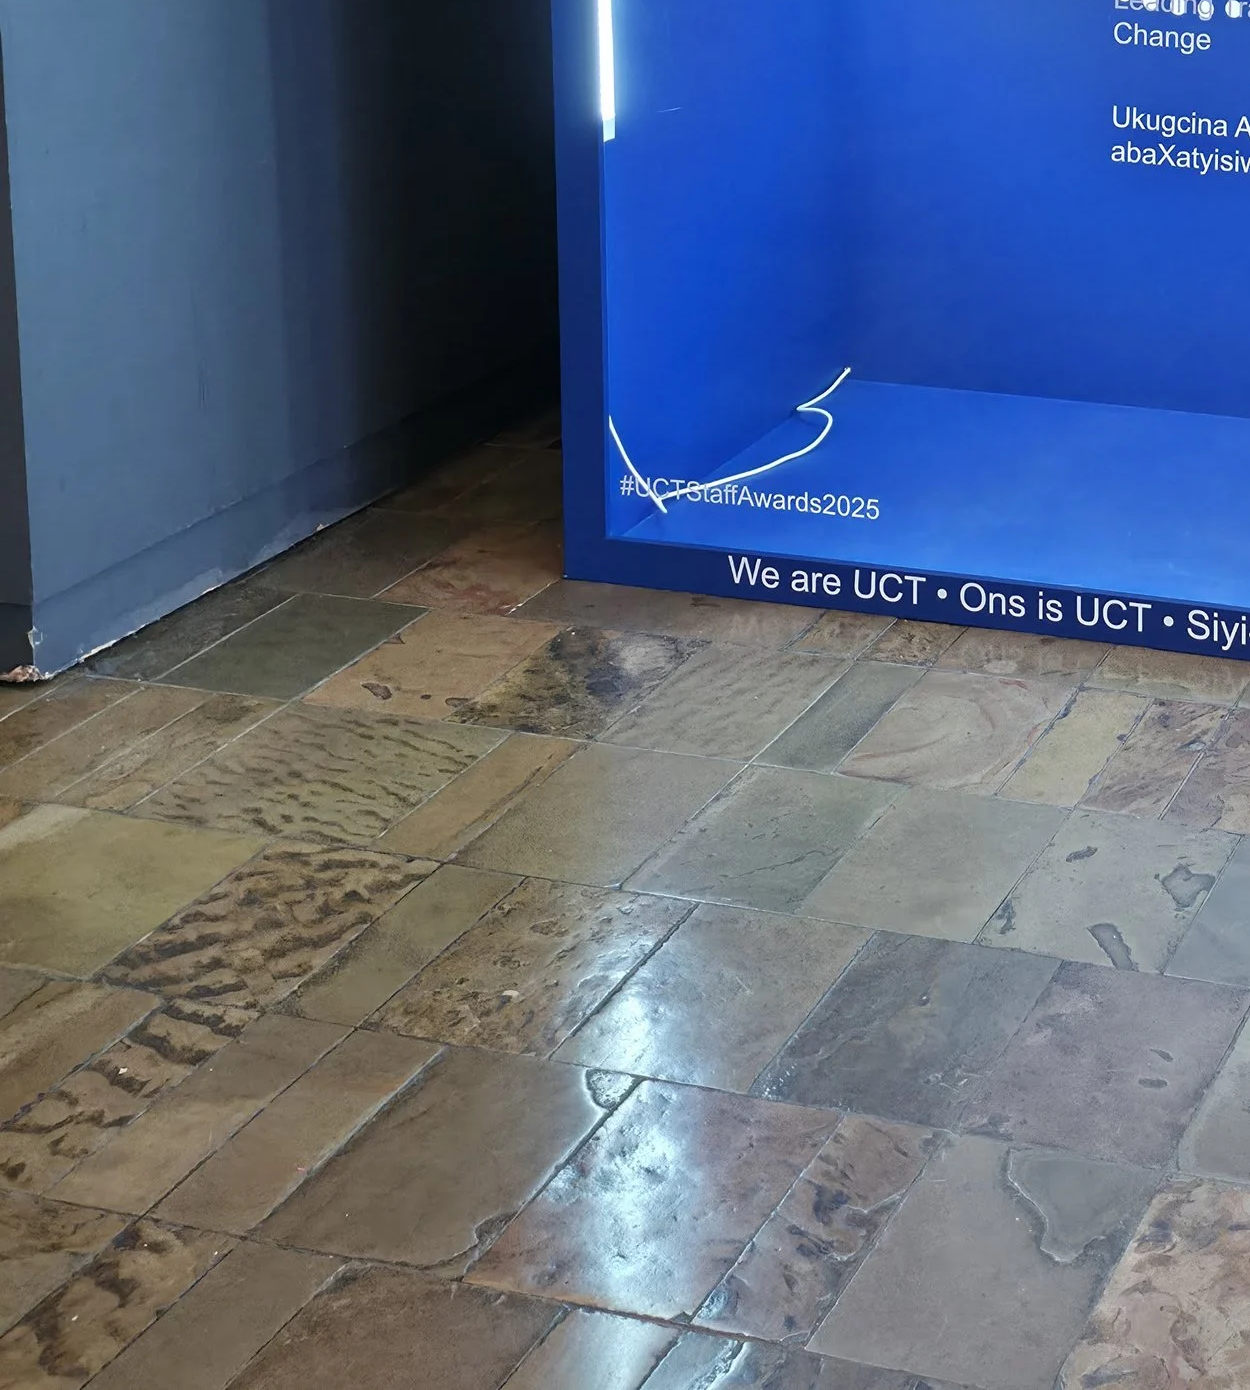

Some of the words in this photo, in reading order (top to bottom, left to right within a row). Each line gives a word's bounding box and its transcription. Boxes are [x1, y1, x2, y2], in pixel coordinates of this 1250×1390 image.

[1113, 21, 1211, 55] Change
[1111, 105, 1227, 138] Ukugcina
[619, 474, 880, 520] #UCTStaffAwards2025
[727, 555, 780, 589] We
[791, 570, 841, 596] are
[853, 569, 926, 606] UCT
[960, 582, 1026, 618] Ons
[1039, 588, 1063, 622] is
[1076, 594, 1151, 632] UCT
